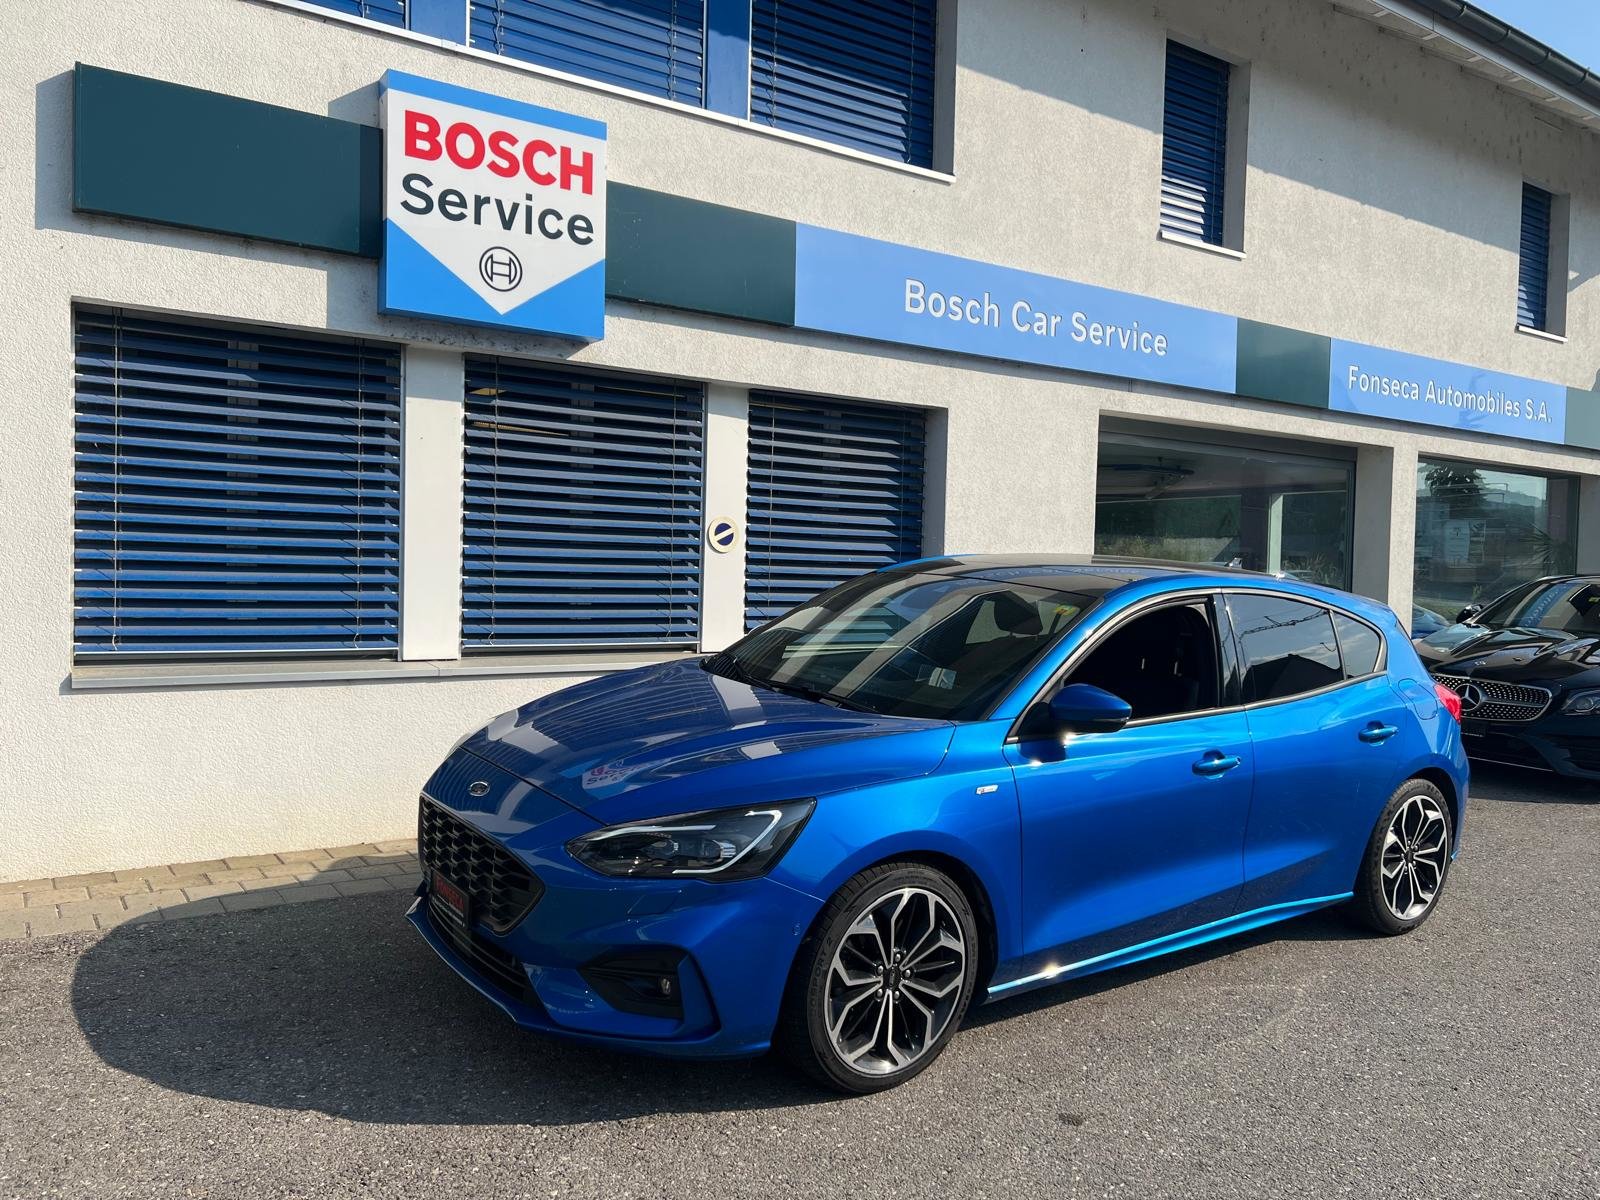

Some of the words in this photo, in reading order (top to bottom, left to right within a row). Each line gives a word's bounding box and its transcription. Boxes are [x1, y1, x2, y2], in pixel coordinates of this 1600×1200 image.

[404, 109, 594, 196] BOSCH
[400, 173, 594, 246] Service
[904, 278, 1000, 328] Bosch
[1011, 300, 1062, 337] Car
[1071, 311, 1168, 357] Service
[1347, 365, 1420, 401] Fonseca
[1425, 380, 1521, 418] Automobiles
[1526, 398, 1553, 423] S.A.
